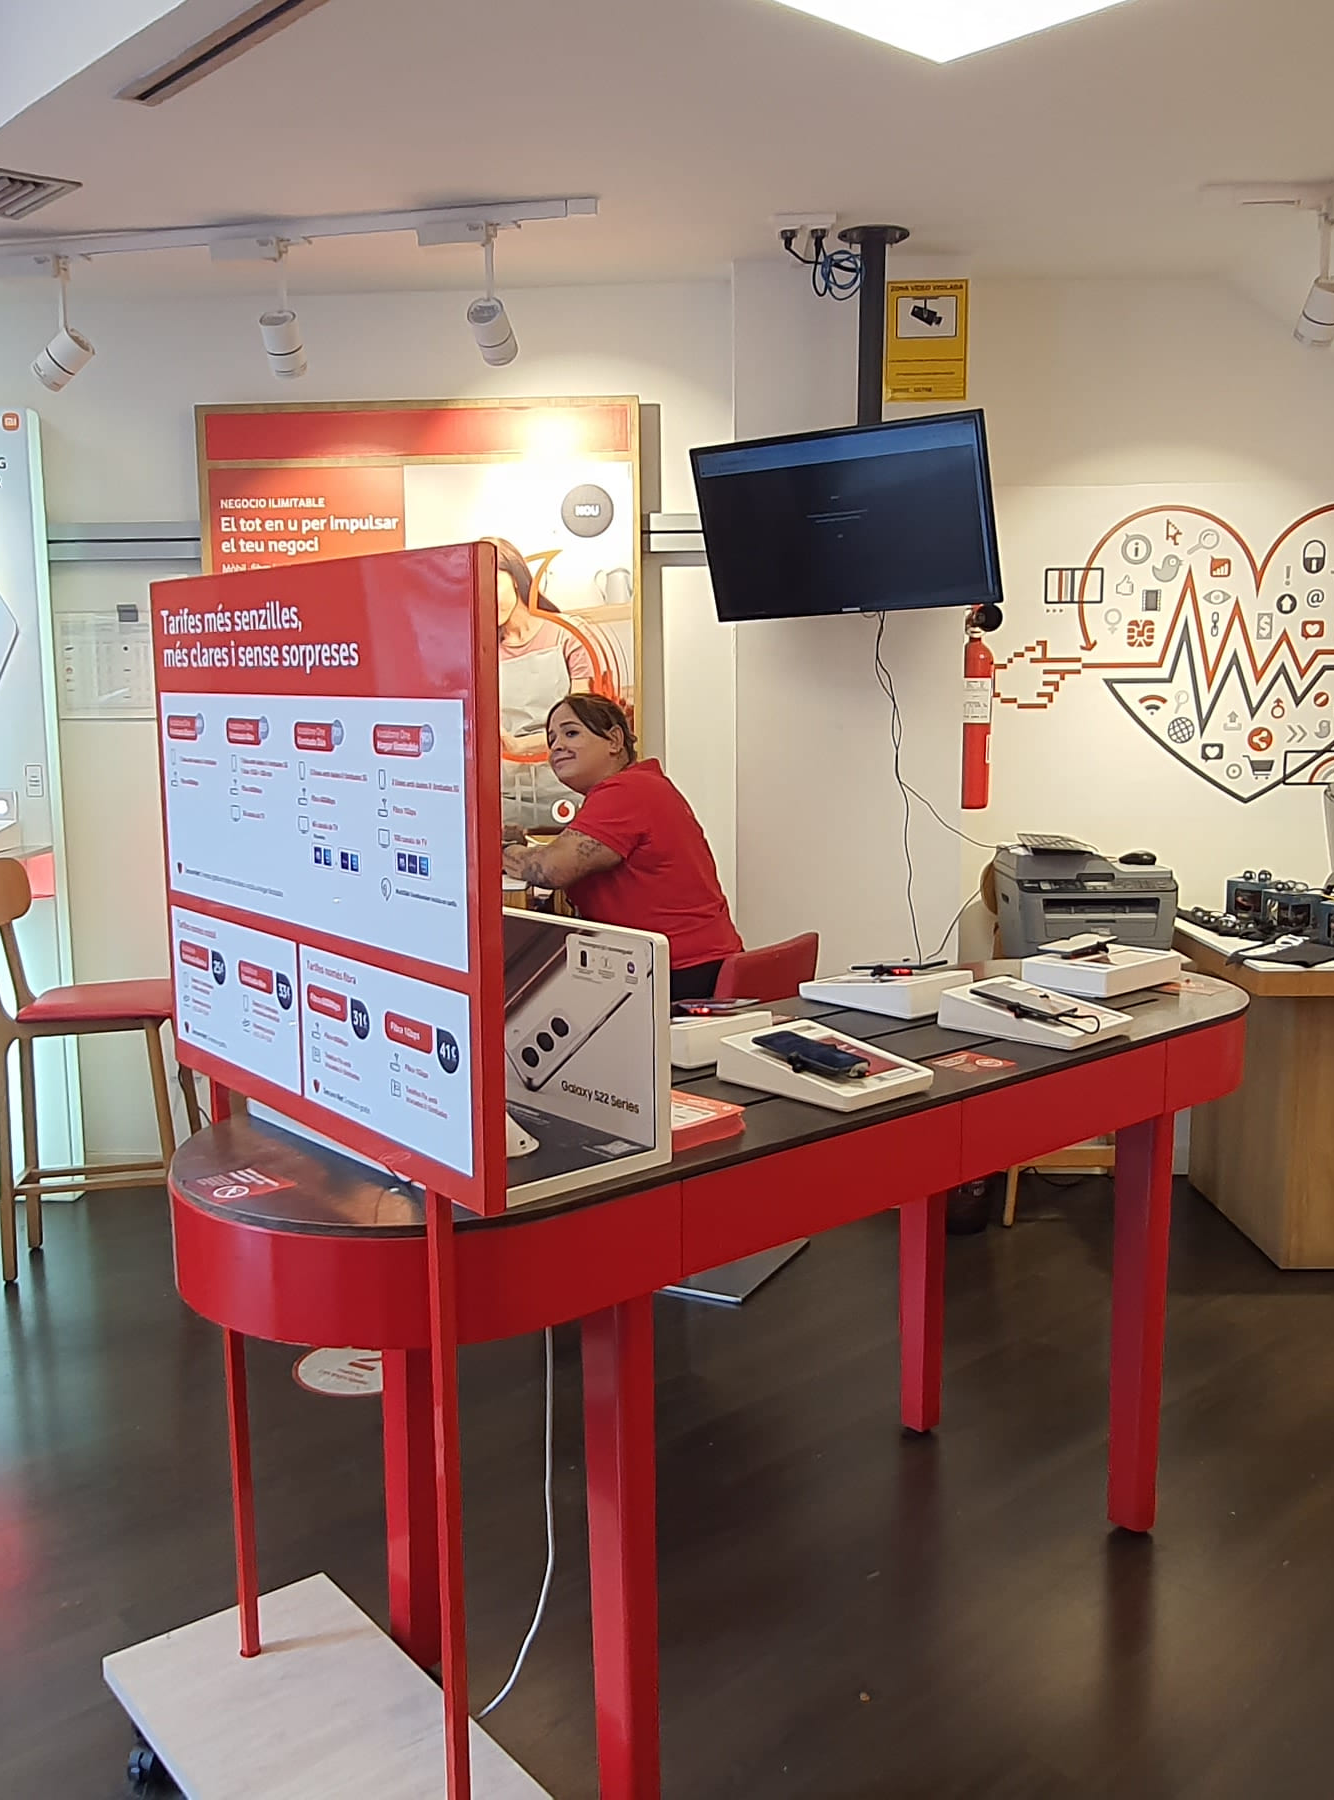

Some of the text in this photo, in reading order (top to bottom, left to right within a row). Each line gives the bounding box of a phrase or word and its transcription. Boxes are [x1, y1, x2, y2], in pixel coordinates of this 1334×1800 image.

[220, 497, 326, 508] NEGOCIO ILIMITABLE
[221, 514, 399, 534] El tot en u per impulsar
[221, 536, 319, 556] el teu negoci
[160, 600, 303, 635] Tarifes més senzilles,
[163, 640, 359, 674] més clares i sense sorpreses
[561, 1080, 640, 1114] Galaxy S22 Series
